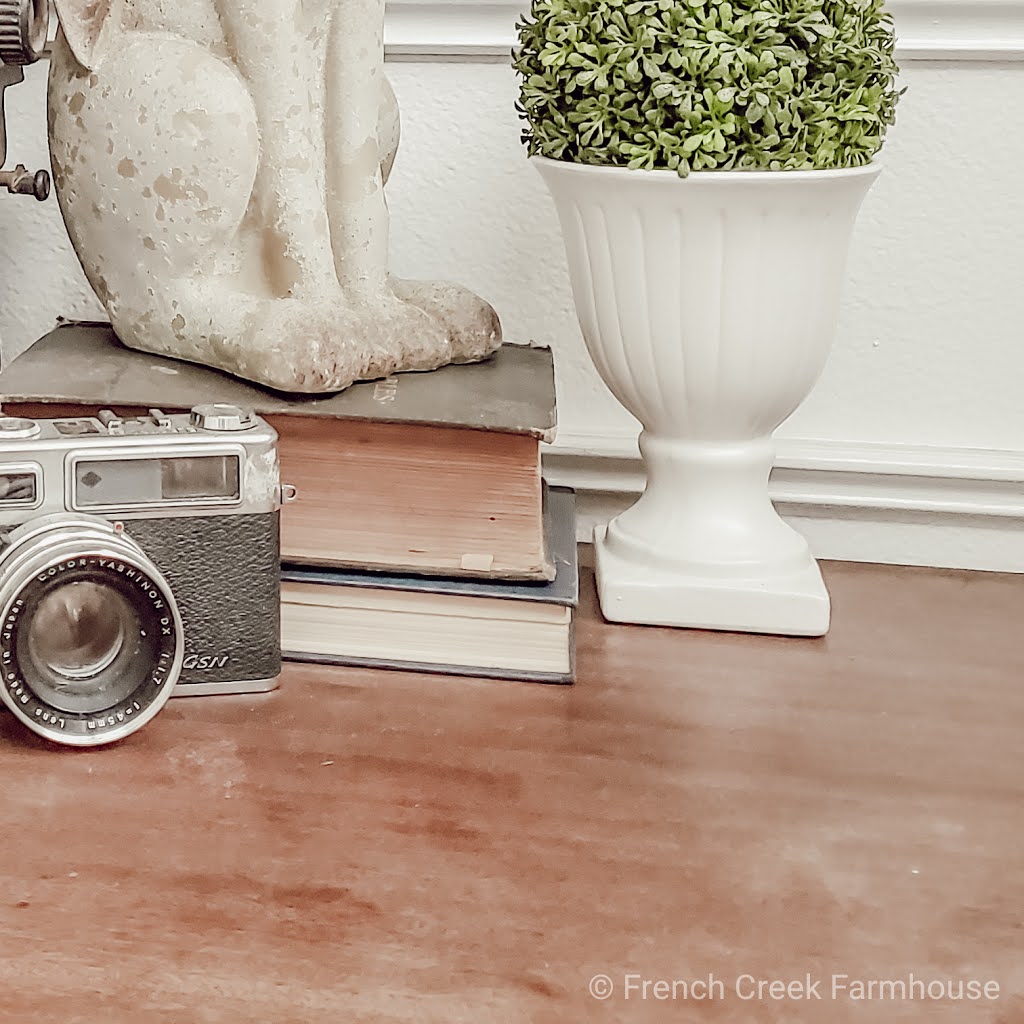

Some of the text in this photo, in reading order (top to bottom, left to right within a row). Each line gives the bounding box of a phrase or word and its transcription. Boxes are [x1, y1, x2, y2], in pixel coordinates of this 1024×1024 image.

[37, 558, 165, 609] COLOR-YASHINON
[160, 618, 171, 635] DX
[3, 599, 65, 728] Lens made in Japan
[182, 655, 228, 669] GSN
